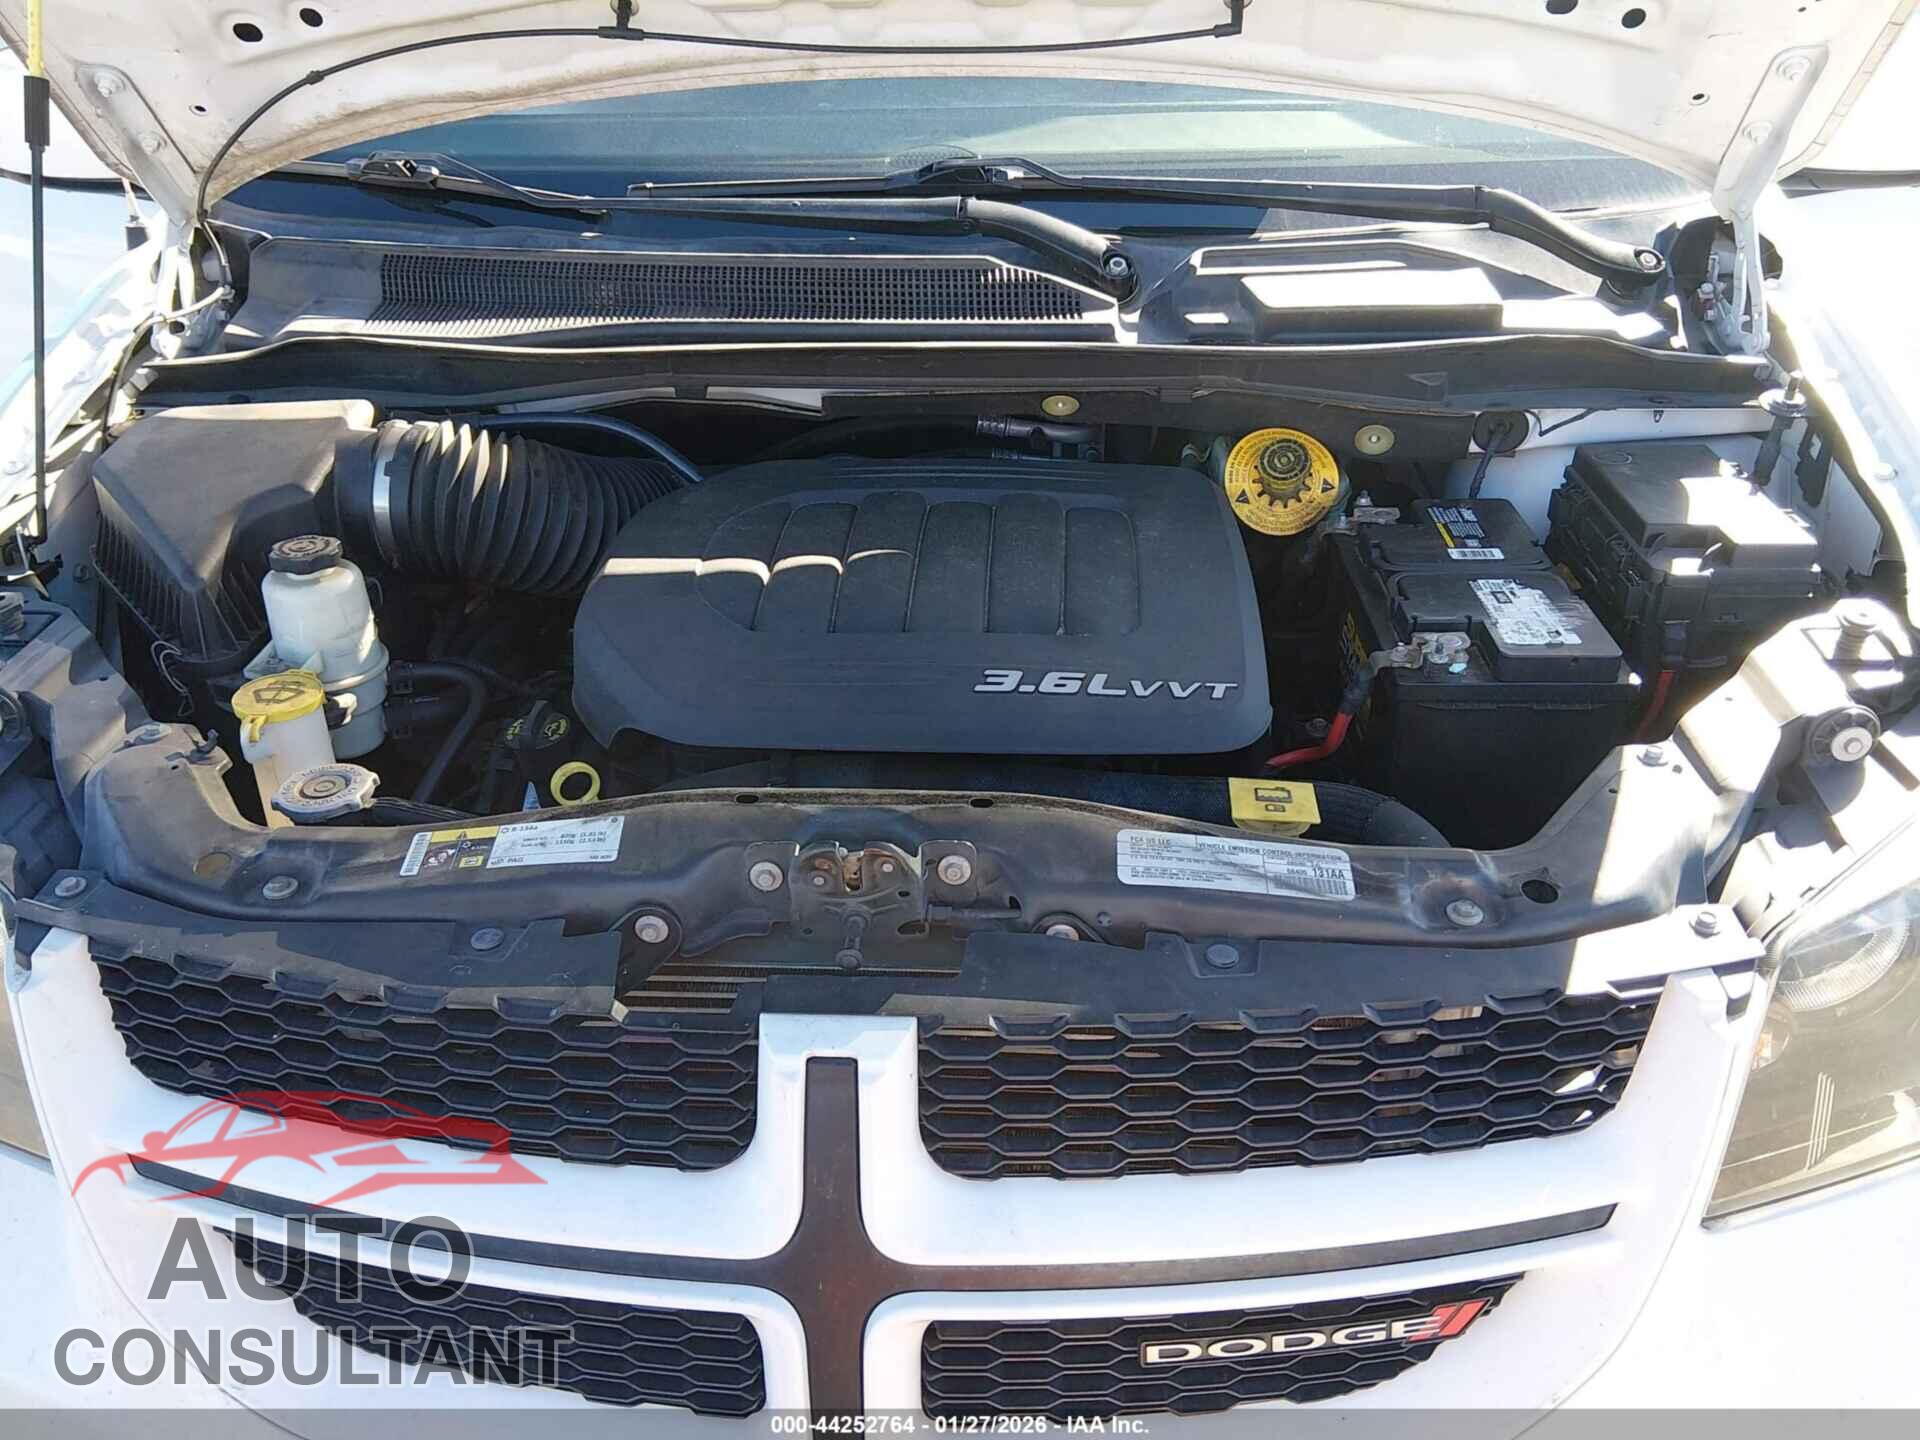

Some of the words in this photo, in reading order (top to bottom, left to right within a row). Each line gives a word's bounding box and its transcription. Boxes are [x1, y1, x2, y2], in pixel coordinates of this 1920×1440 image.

[1129, 680, 1239, 699] VVT
[1199, 842, 1226, 851] VEHICLE
[1262, 848, 1293, 857] CONTROL
[1145, 1315, 1441, 1363] DODGE
